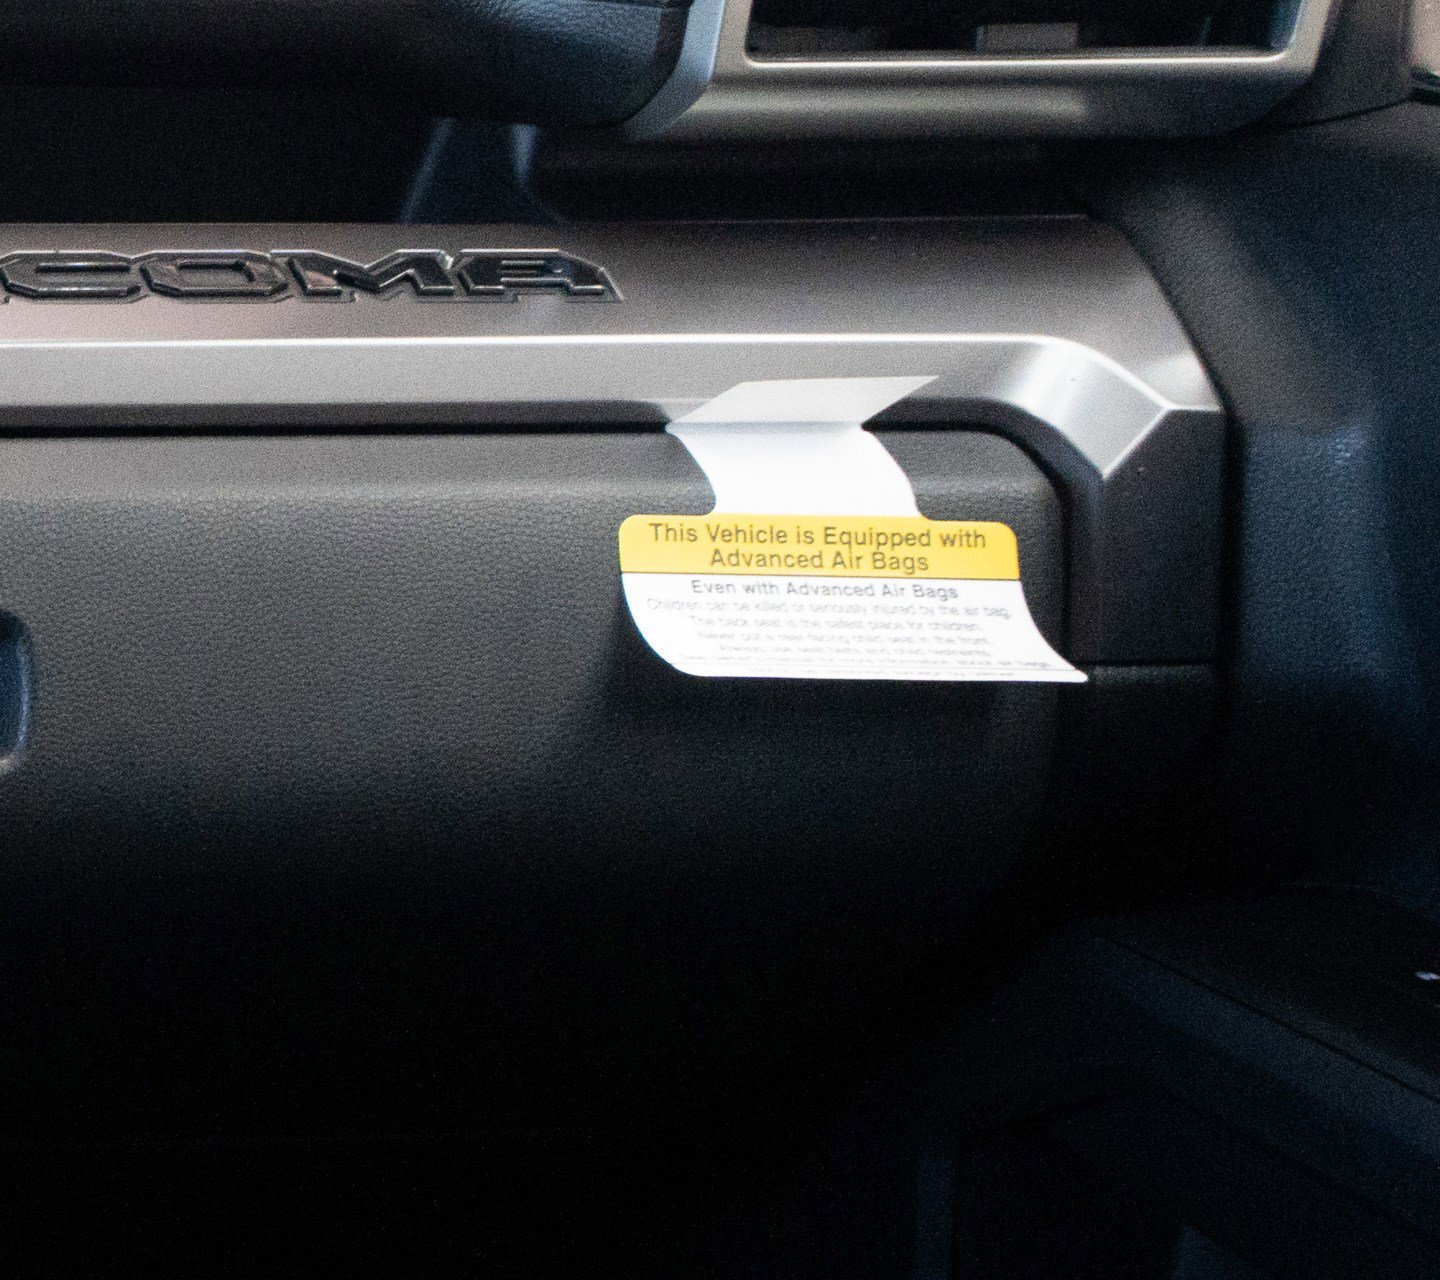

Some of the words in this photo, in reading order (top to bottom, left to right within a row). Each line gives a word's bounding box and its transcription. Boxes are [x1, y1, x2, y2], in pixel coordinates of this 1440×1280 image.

[648, 522, 698, 543] This
[705, 523, 789, 545] Vehicle
[796, 525, 814, 545] is
[823, 526, 931, 551] Equipped
[939, 528, 986, 549] with
[710, 548, 824, 569] Advanced
[831, 550, 863, 570] Air
[872, 551, 929, 575] Bags
[692, 580, 736, 594] Even
[742, 580, 779, 595] with
[785, 581, 875, 597] Advanced
[881, 583, 906, 598] Air
[912, 583, 958, 601] Bags
